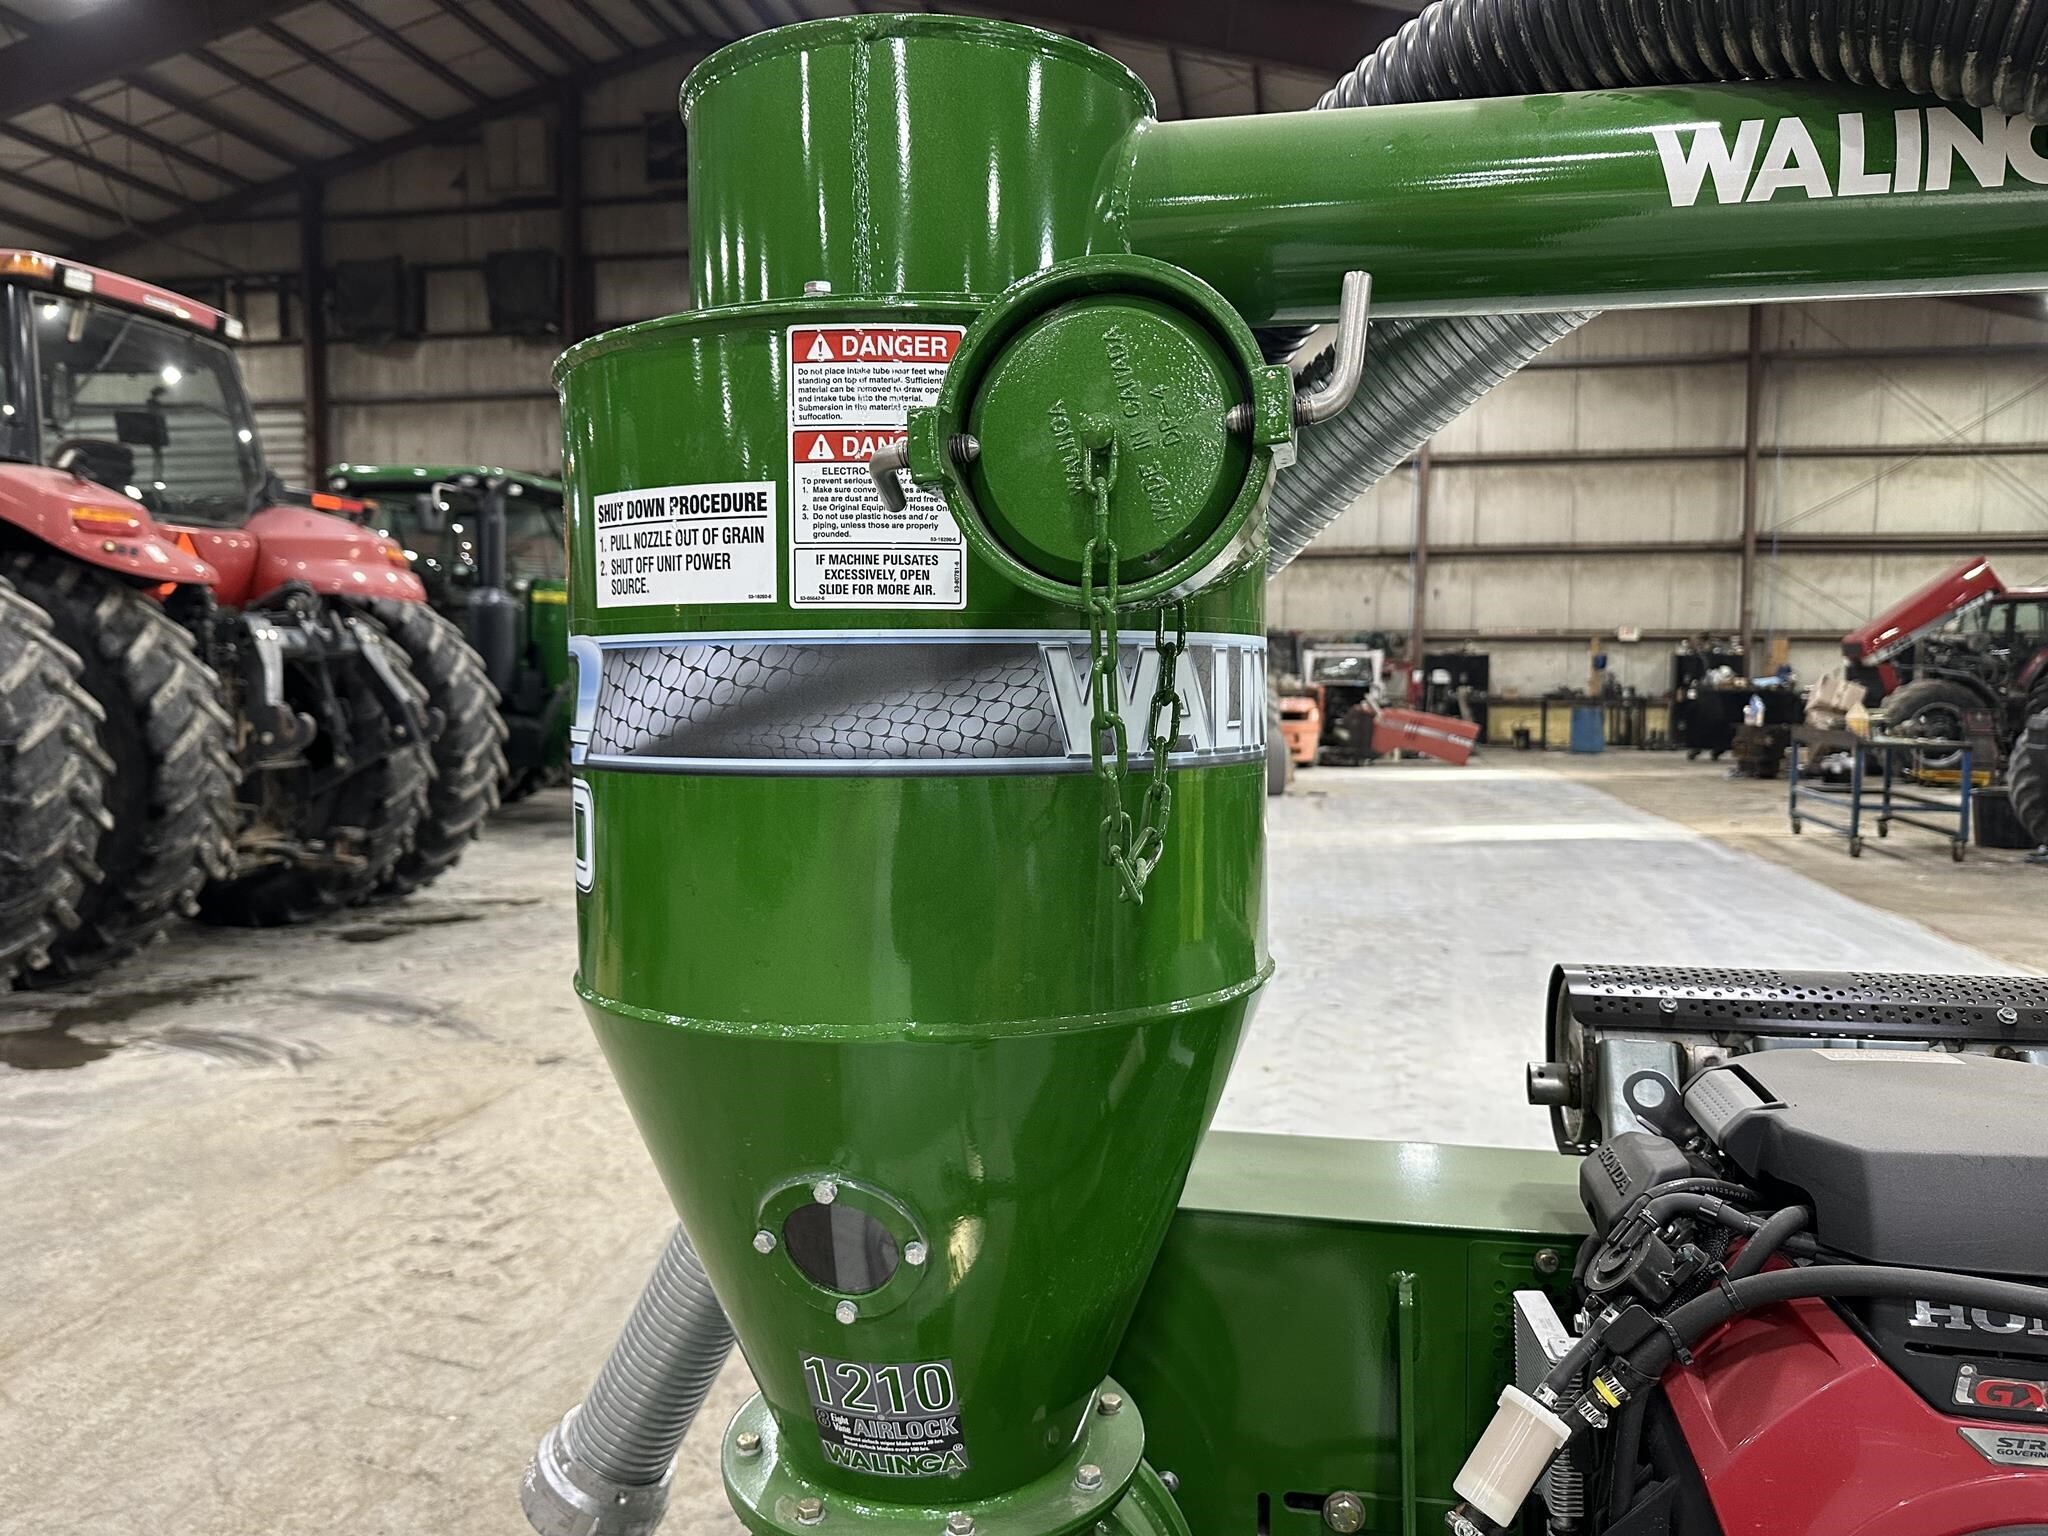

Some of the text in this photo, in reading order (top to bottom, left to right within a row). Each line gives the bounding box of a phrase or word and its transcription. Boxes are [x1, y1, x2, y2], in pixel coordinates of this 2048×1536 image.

[842, 335, 948, 357] DANGER
[825, 368, 846, 377] place
[798, 376, 830, 386] standing
[844, 377, 857, 386] top
[905, 376, 943, 384] Sufficient
[799, 412, 843, 420] suffocation.
[813, 478, 842, 487] prevent
[923, 495, 941, 503] free.
[599, 492, 768, 523] SHUT DOWN PROCEDURE
[813, 504, 827, 512] Use
[829, 504, 859, 513] Original
[910, 504, 935, 512] Hoses
[855, 512, 882, 522] plastic
[813, 521, 839, 531] piping,
[841, 521, 866, 529] unless
[906, 522, 939, 531] properly
[600, 526, 764, 553] 1. PULL NOZZLE OUT OF GRAIN
[813, 530, 852, 539] grounded.
[601, 553, 731, 576] 2. SHUT OFF UNIT POWER
[816, 554, 939, 566] IF MACHINE PULSATES
[824, 569, 930, 582] EXCESSIVELY, OPEN
[611, 578, 650, 595] SOURCE.
[819, 584, 936, 596] SLIDE FOR MORE AIR.
[1598, 1145, 1633, 1197] HONDA
[804, 1356, 954, 1414] 1210
[853, 1416, 959, 1440] AIRLOCK
[1996, 1449, 2048, 1458] GOVERN
